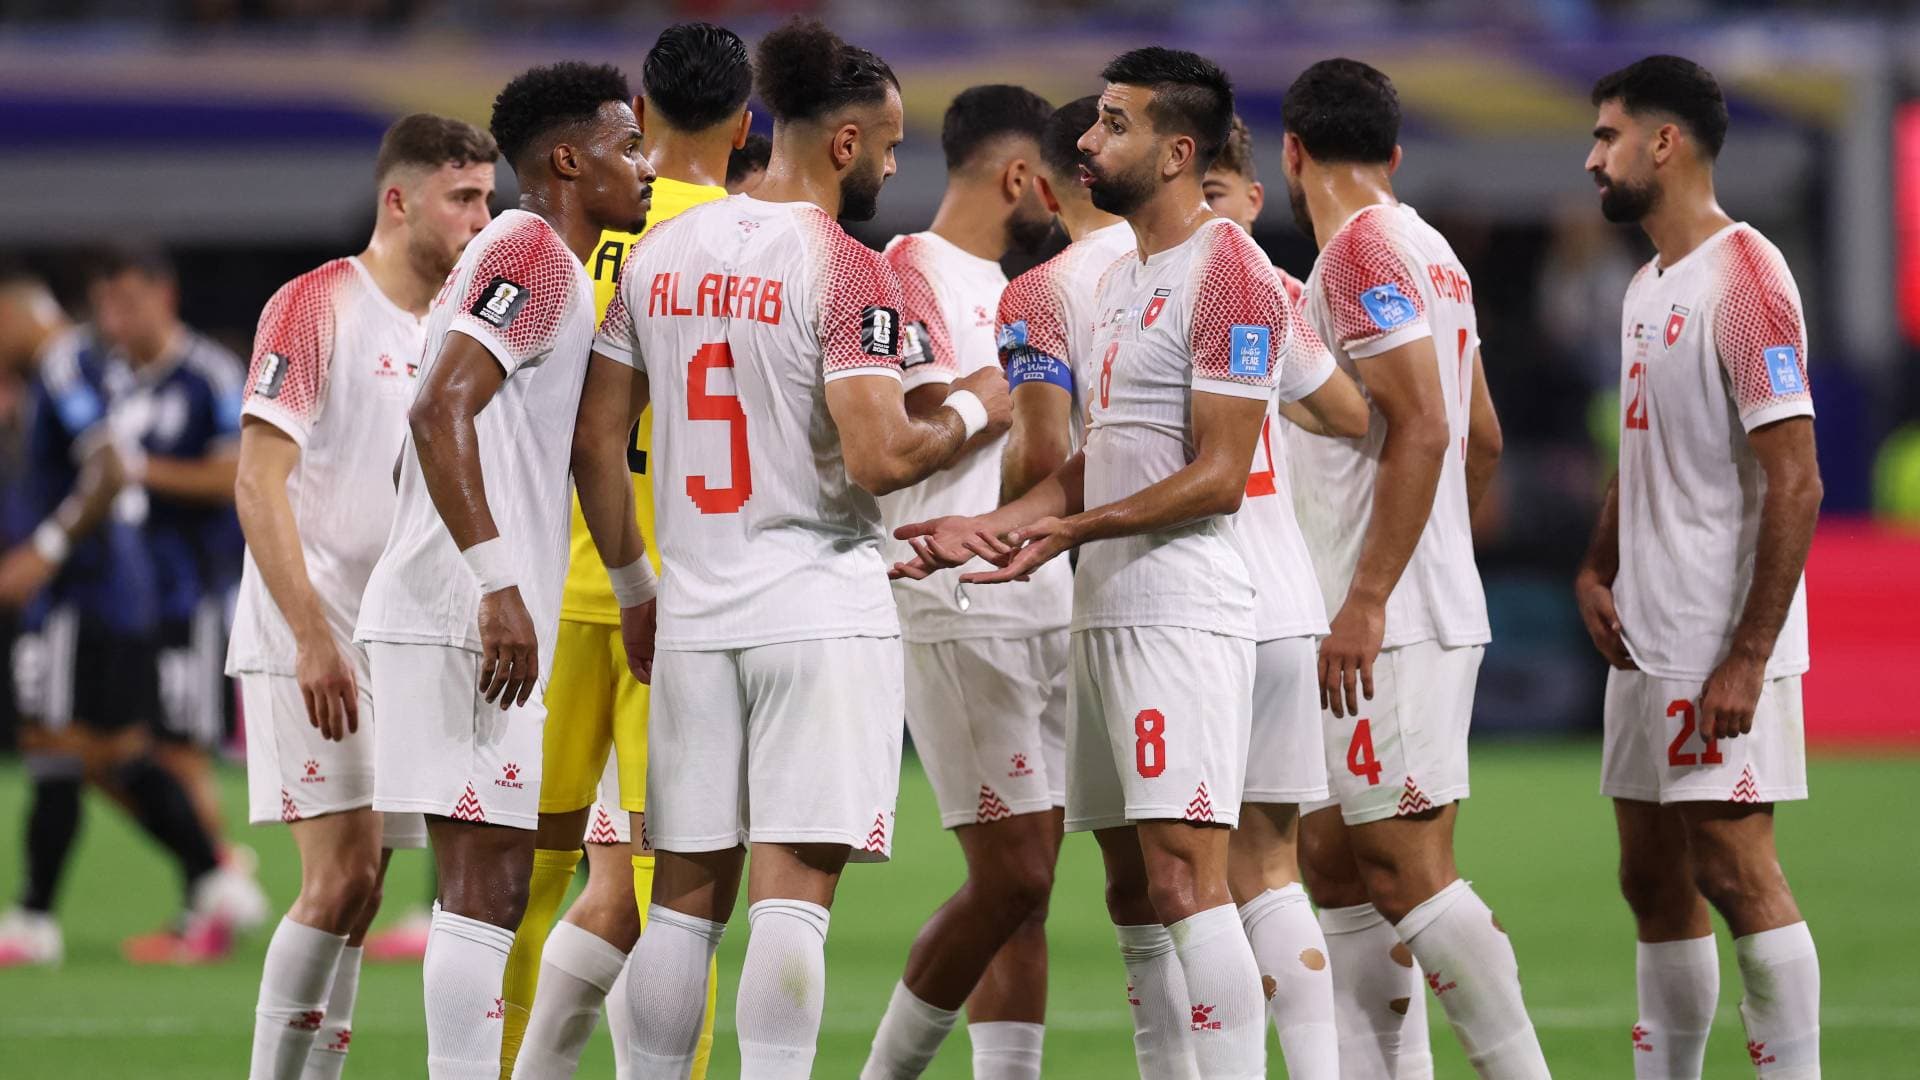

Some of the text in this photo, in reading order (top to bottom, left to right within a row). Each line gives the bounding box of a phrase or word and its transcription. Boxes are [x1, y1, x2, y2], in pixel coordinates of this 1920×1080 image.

[1013, 352, 1055, 369] UNITES
[1027, 363, 1059, 375] World
[1101, 342, 1119, 409] 8
[686, 343, 753, 514] 5
[1135, 708, 1166, 778] 8
[1347, 718, 1382, 786] 4
[495, 779, 524, 789] KELME
